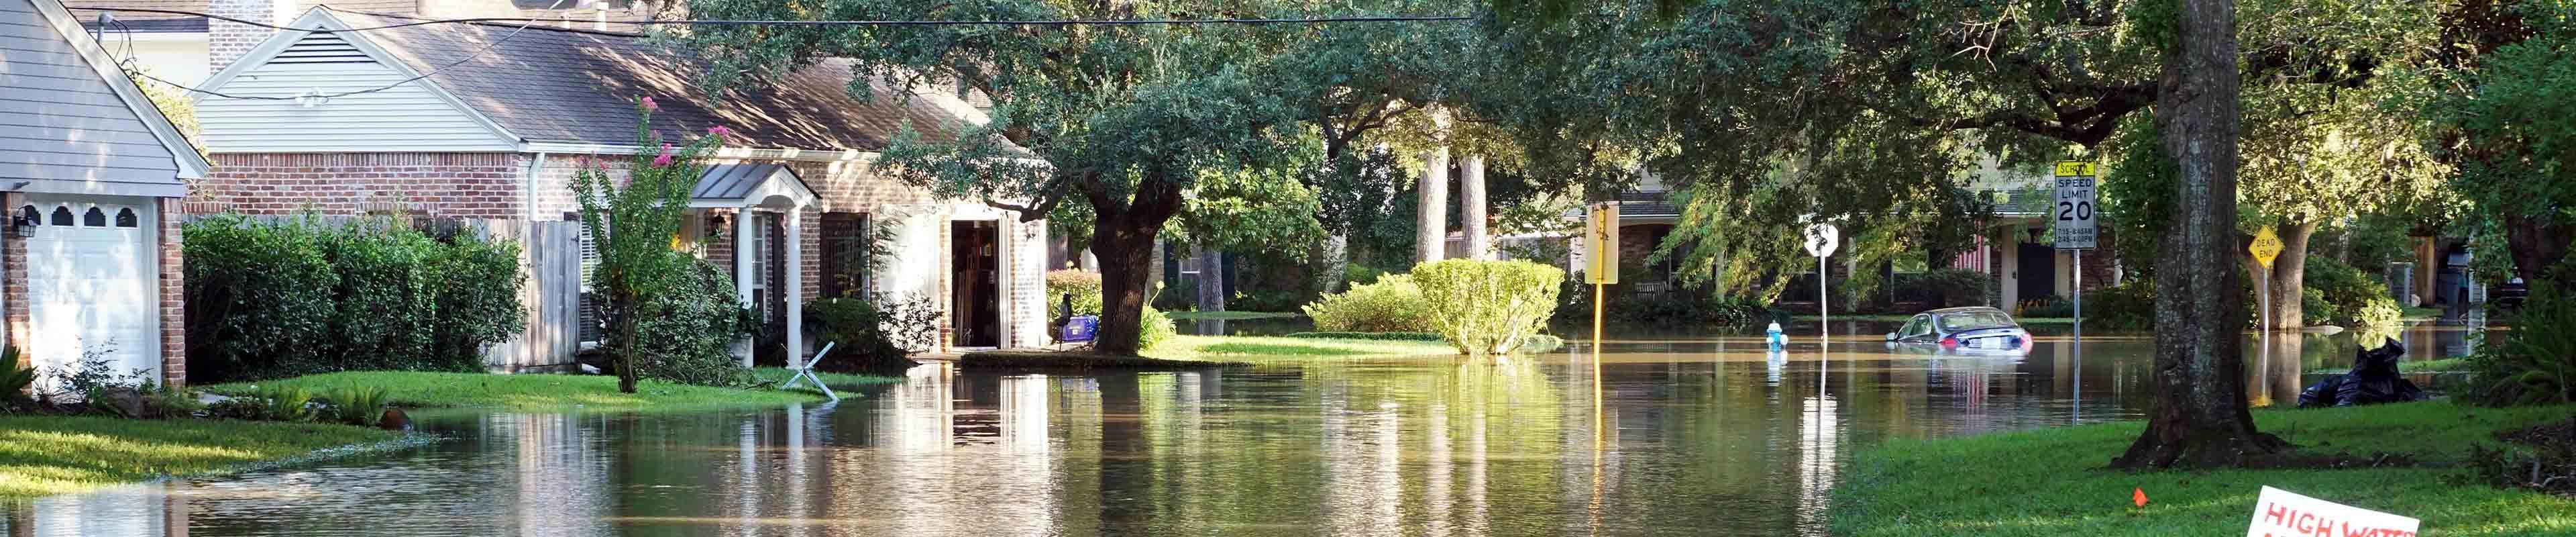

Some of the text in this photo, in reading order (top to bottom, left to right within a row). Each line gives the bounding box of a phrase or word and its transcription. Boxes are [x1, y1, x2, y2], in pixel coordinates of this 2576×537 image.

[2059, 179, 2092, 187] SPEED
[2061, 190, 2088, 199] LIMIT
[2059, 201, 2091, 221] 20
[2257, 238, 2275, 248] DEAD
[2259, 249, 2273, 258] END
[2264, 502, 2333, 537] HIGH
